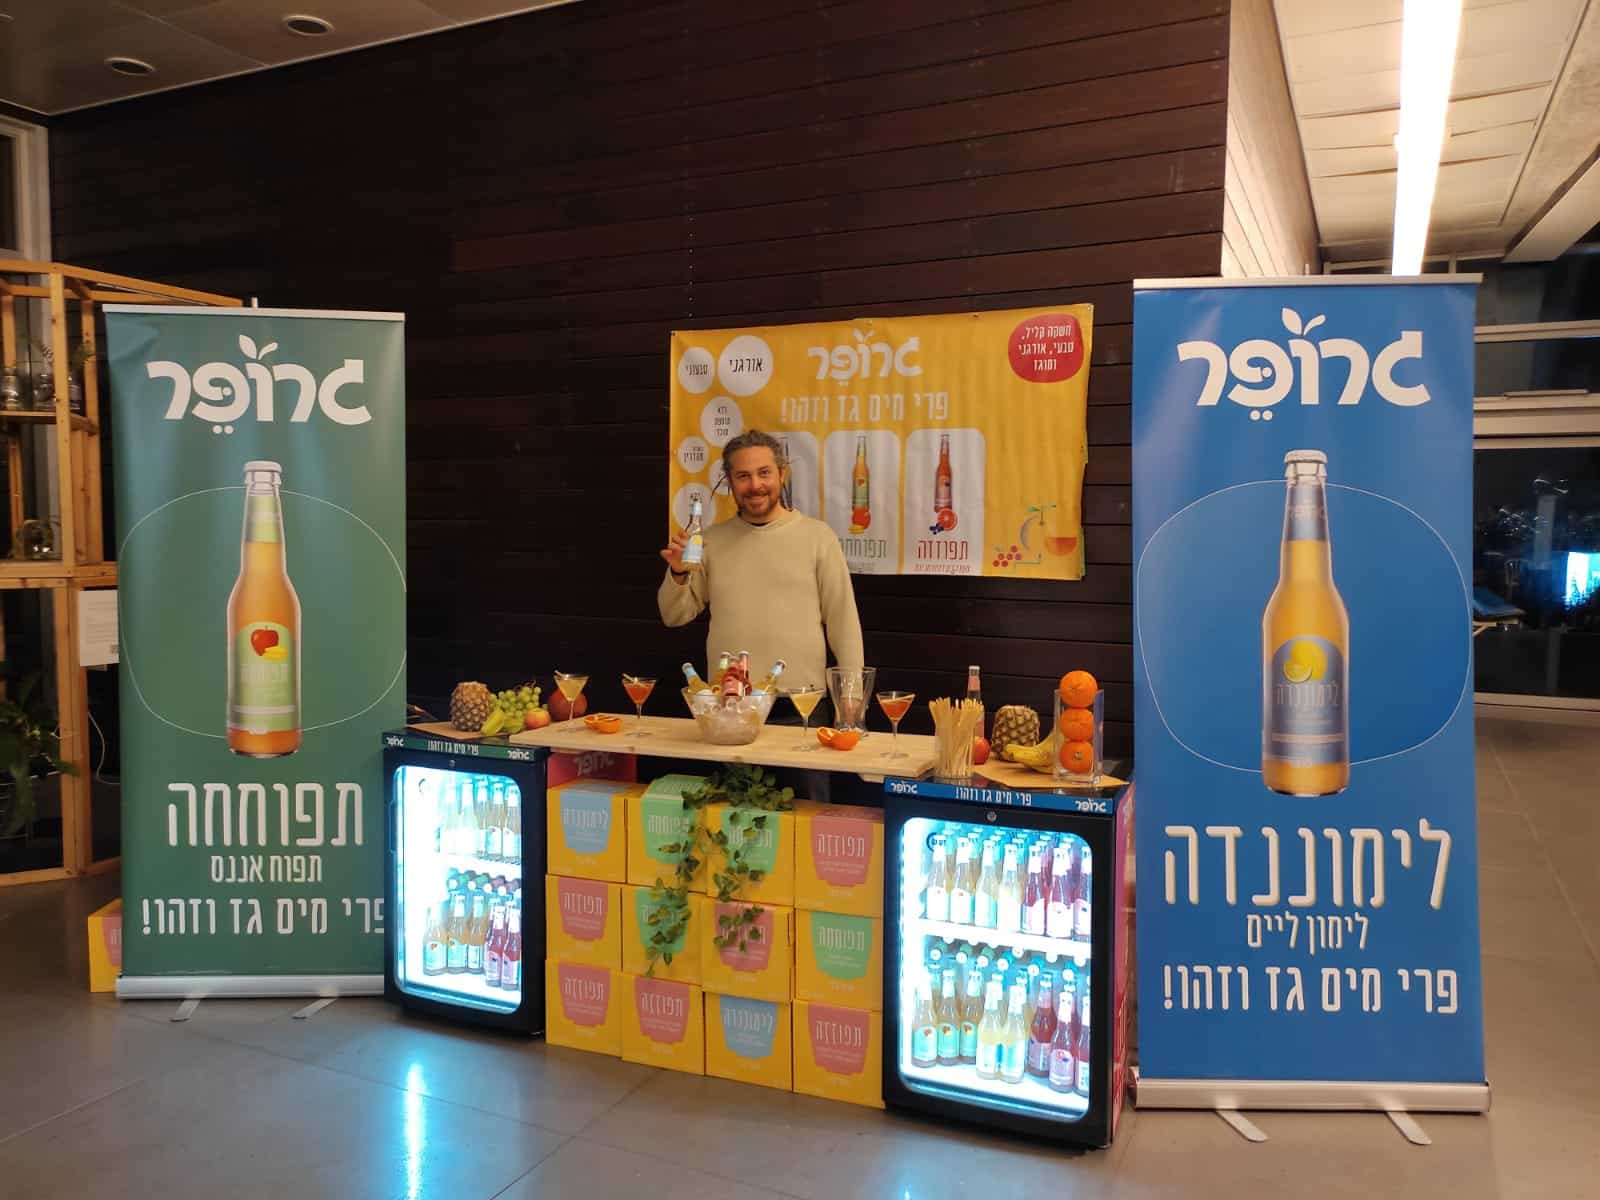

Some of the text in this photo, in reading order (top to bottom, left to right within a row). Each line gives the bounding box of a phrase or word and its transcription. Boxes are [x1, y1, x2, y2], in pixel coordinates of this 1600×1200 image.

[729, 358, 763, 373] אורגני
[781, 392, 948, 424] פרי מים גז וזהו!
[918, 540, 969, 560] תפוזזה
[982, 788, 992, 801] גז
[995, 790, 1012, 804] מים
[1016, 792, 1032, 806] פרי
[168, 782, 363, 846] תפוחחה
[817, 833, 865, 857] תפוזזה
[211, 855, 322, 882] תפוח אננס
[1165, 818, 1451, 909] לימוננדה
[142, 898, 217, 935] וזהו!
[230, 898, 263, 935] גז
[276, 898, 328, 935] מים
[1247, 911, 1369, 955] לימון ליים
[1163, 965, 1458, 1014] פרי מים גז וזהו!
